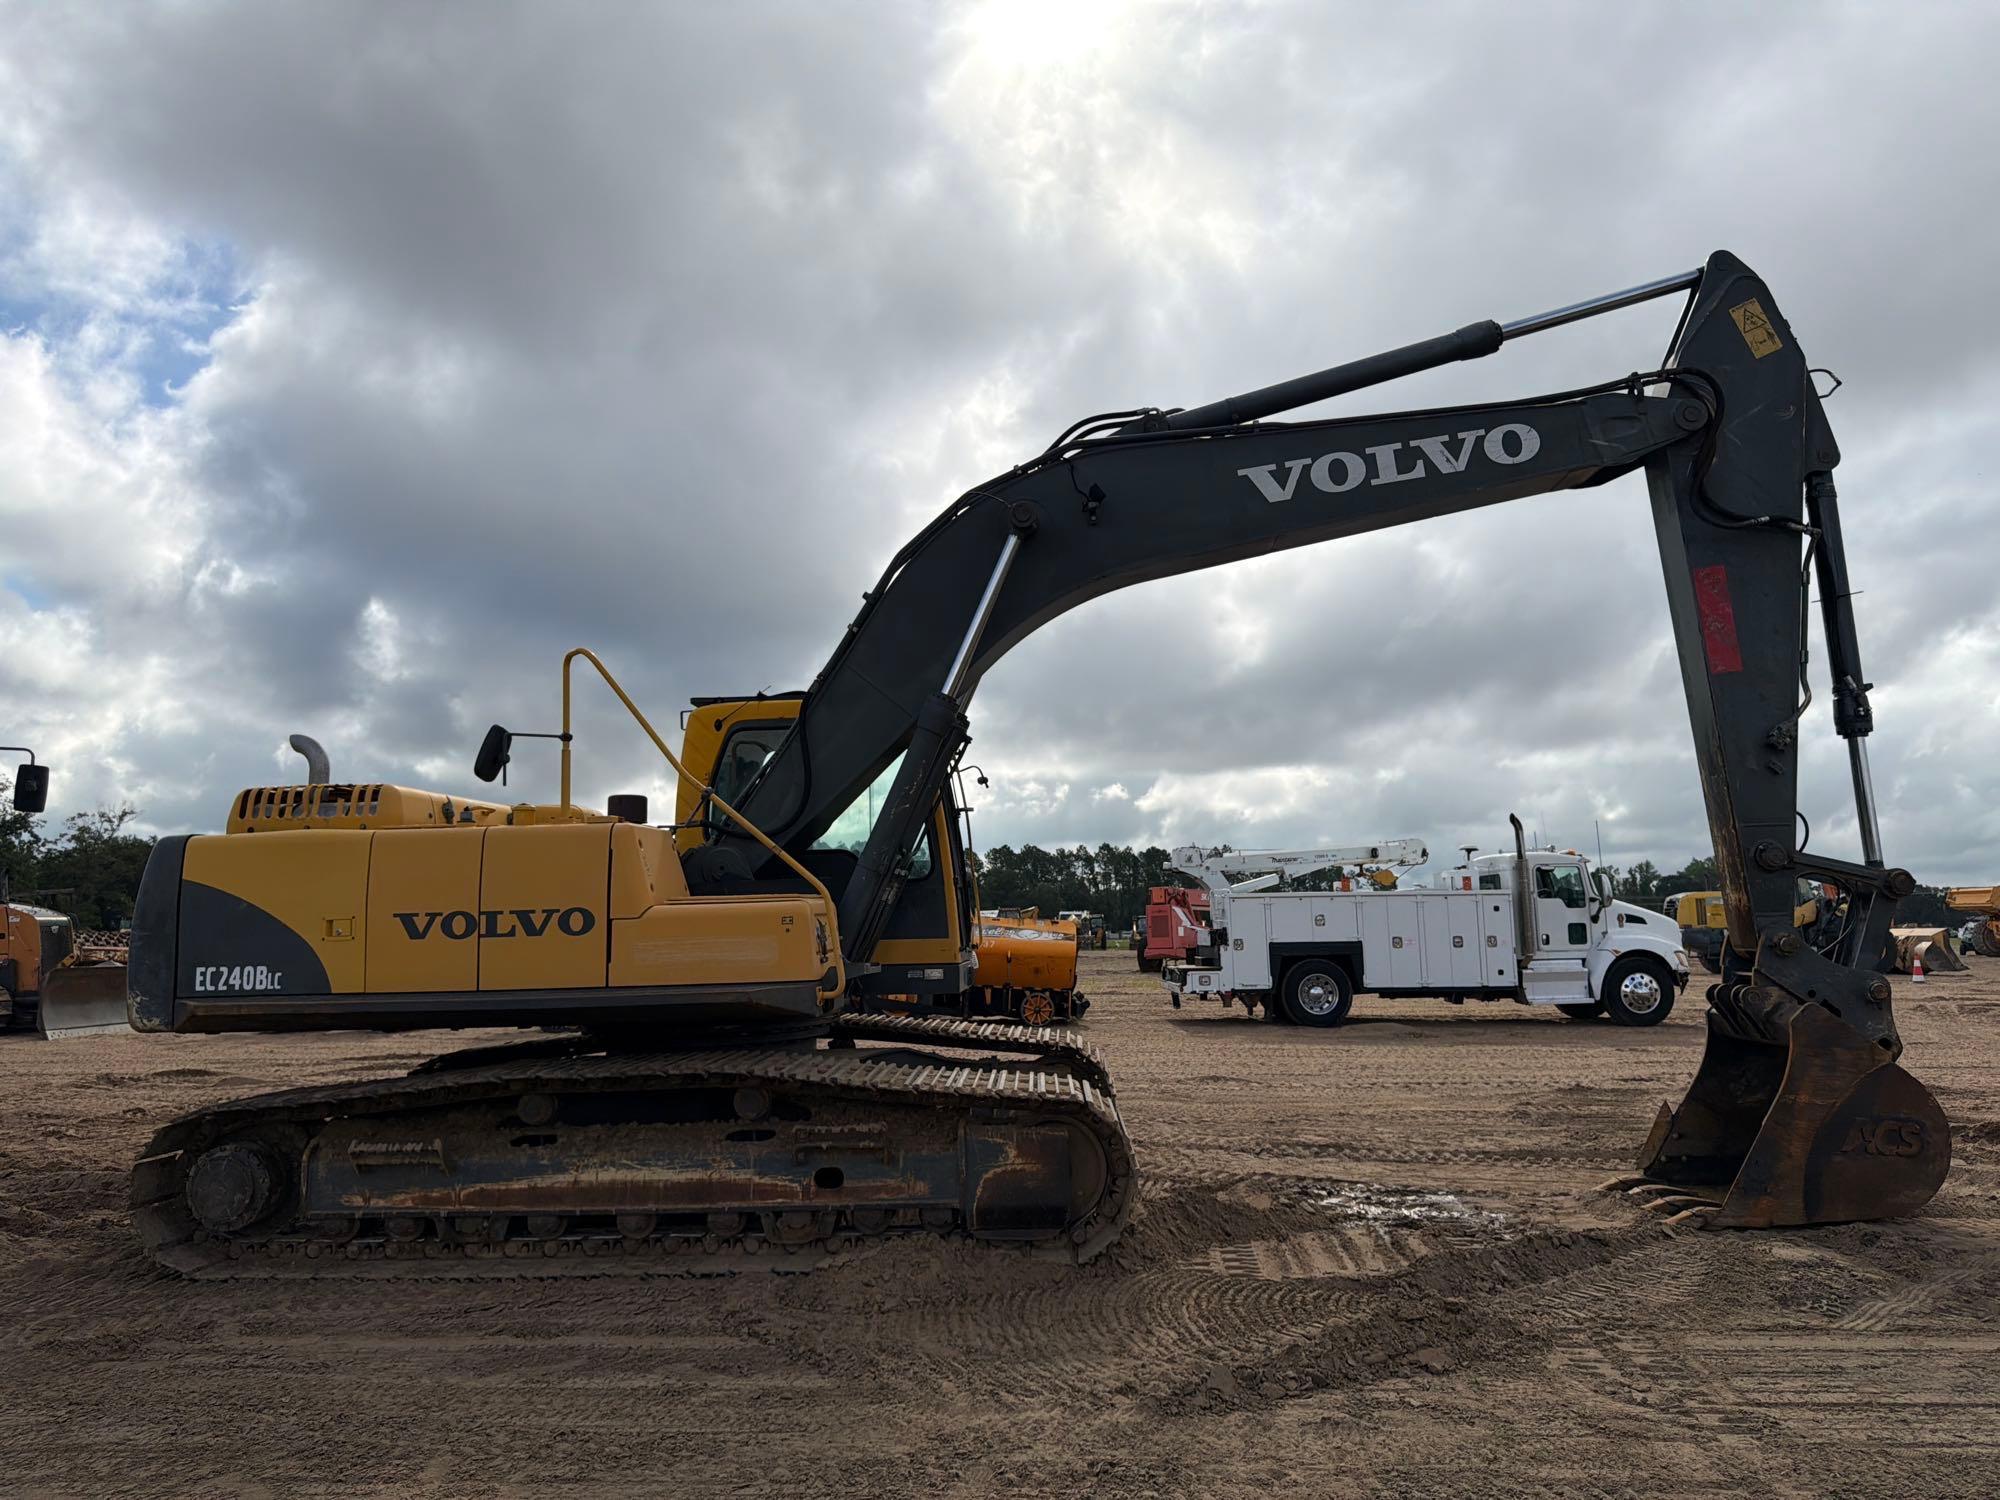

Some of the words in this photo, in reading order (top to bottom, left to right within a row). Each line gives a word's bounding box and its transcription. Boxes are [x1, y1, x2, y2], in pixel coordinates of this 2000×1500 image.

[1237, 423, 1541, 503] VOLVO
[393, 907, 595, 940] VOLVO
[1839, 1119, 1922, 1156] ACS
